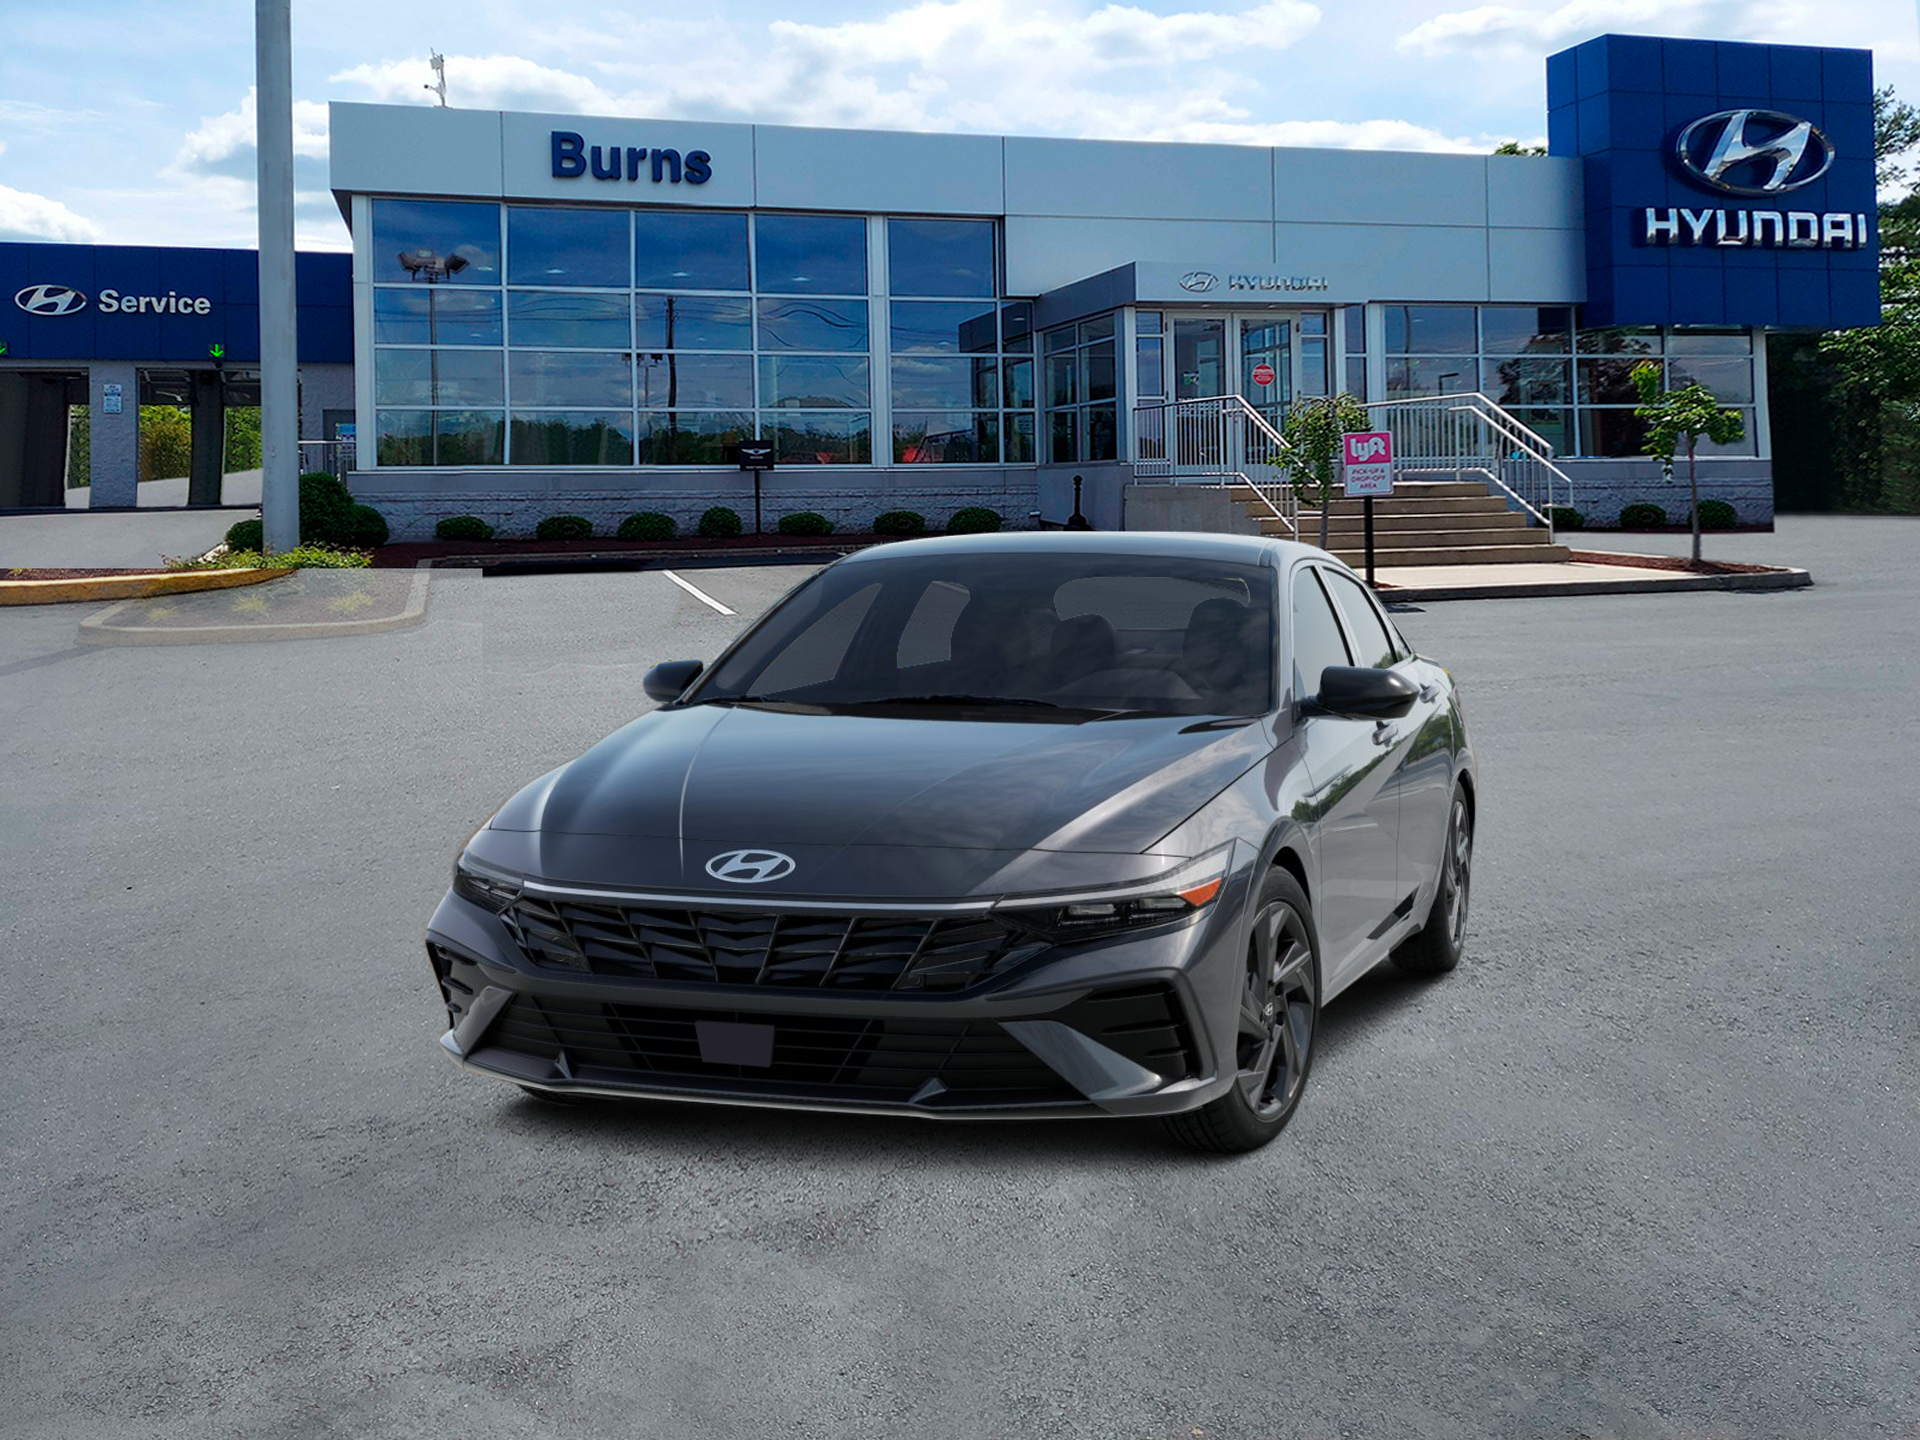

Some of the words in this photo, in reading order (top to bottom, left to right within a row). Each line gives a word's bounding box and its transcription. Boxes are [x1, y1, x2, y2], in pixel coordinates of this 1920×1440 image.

[550, 130, 713, 185] Burns
[1645, 207, 1868, 249] HYUNDAI
[1228, 274, 1329, 292] HYUNDAI
[98, 289, 212, 315] Service
